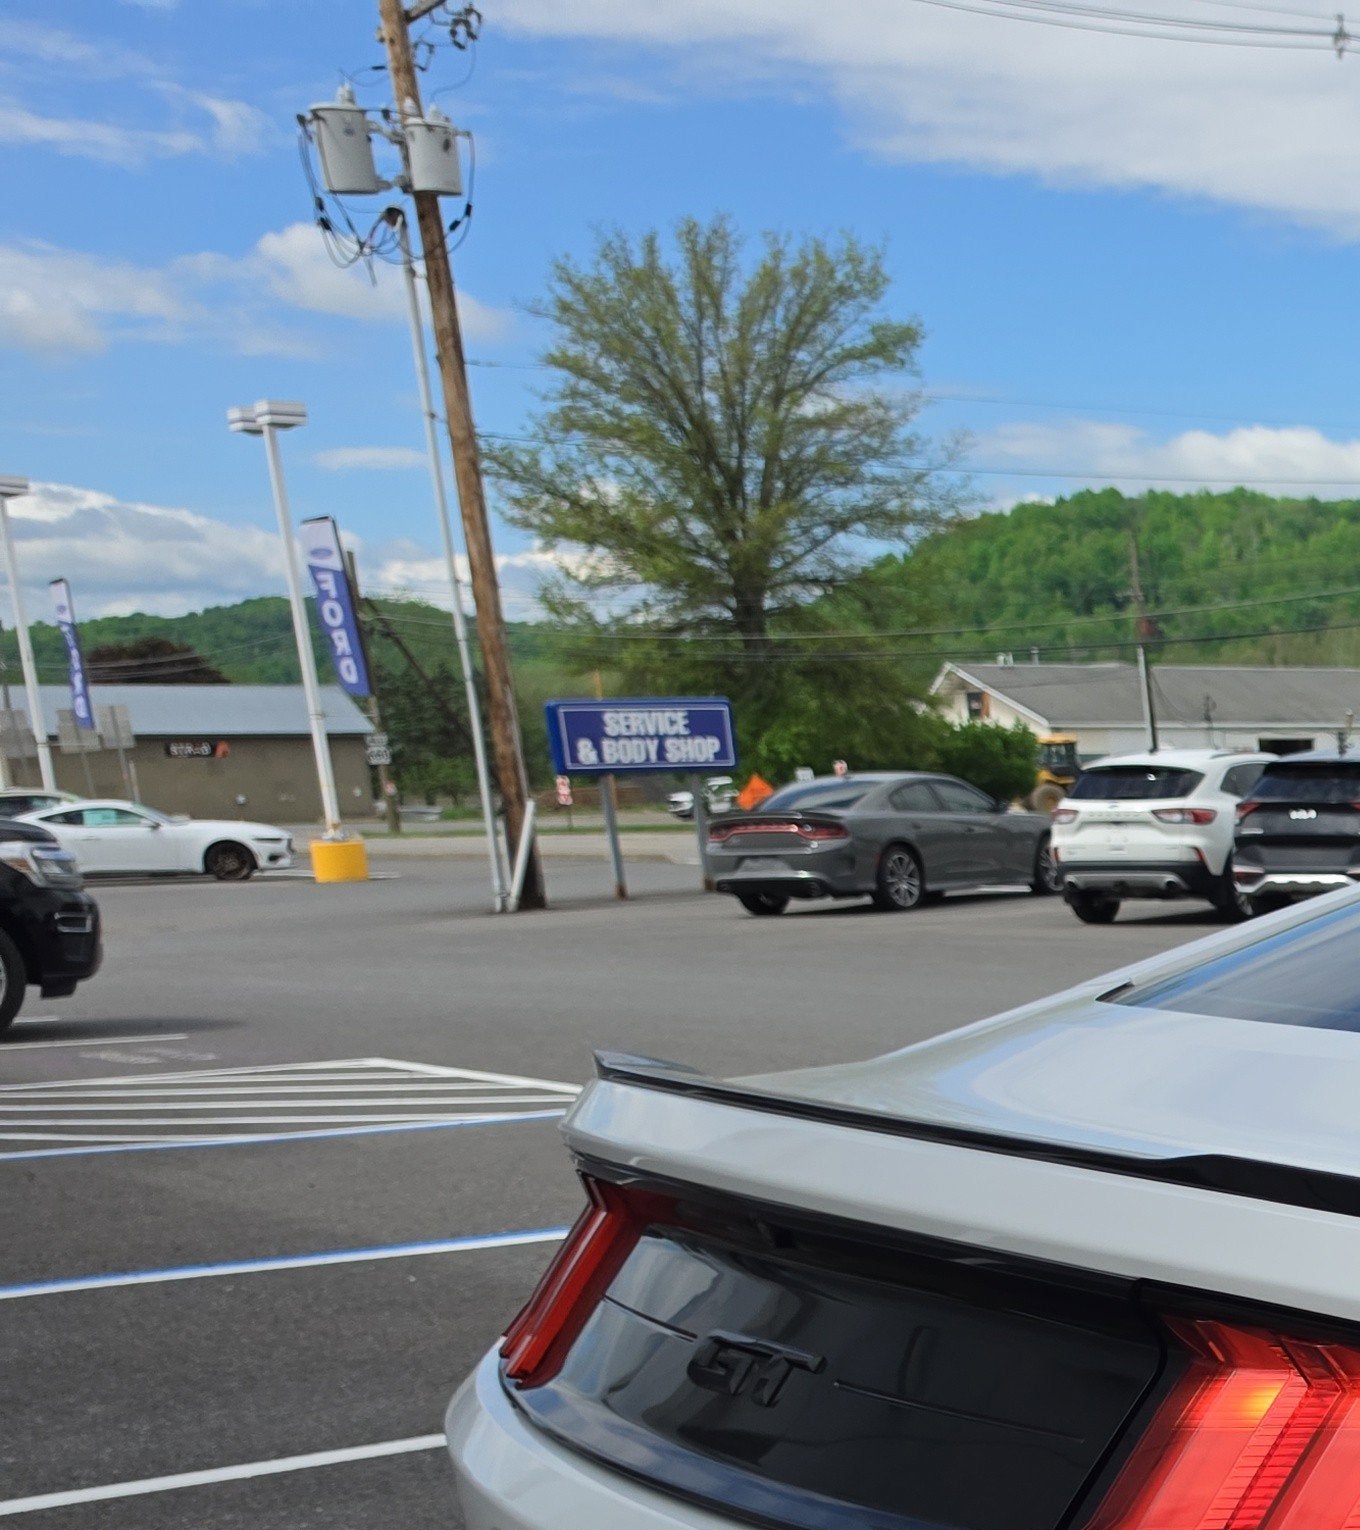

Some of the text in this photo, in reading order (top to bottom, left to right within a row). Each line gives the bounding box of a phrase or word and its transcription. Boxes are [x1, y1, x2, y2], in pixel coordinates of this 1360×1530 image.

[603, 711, 692, 736] SERVICE
[577, 735, 721, 765] & BODY SHOP
[687, 1330, 828, 1408] GT
